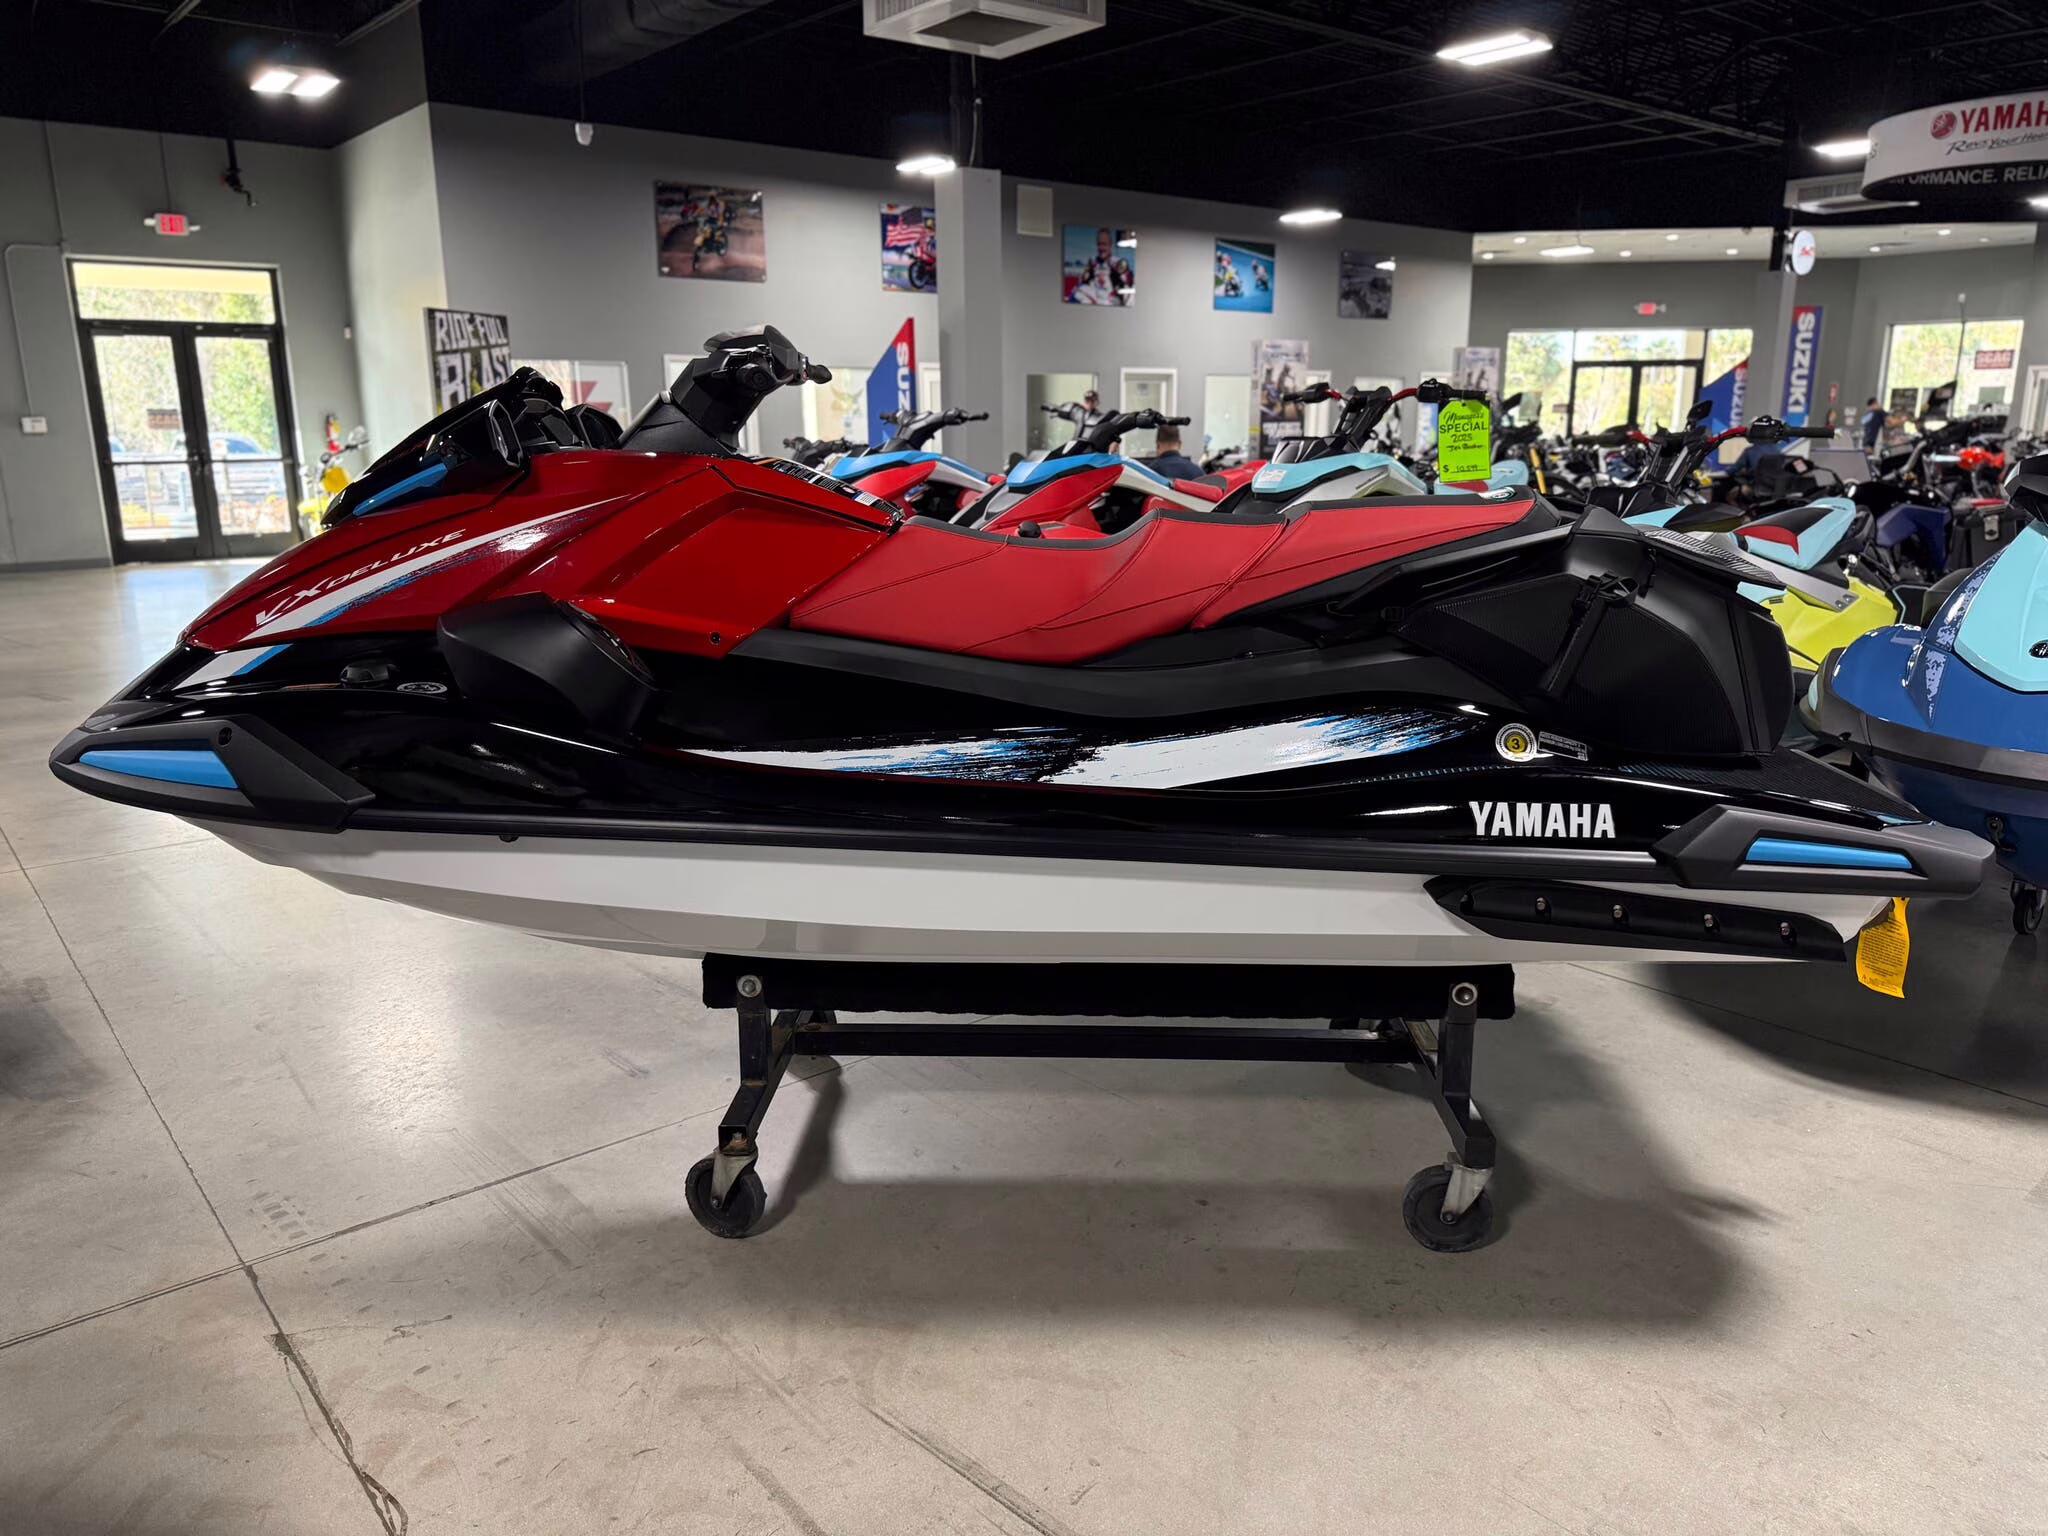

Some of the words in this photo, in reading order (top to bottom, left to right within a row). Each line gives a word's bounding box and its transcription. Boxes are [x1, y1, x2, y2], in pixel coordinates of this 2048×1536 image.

[434, 311, 479, 351] RIDE
[476, 316, 508, 345] FULL
[1788, 311, 1816, 414] SUZUKI
[1440, 422, 1487, 433] SPECIAL
[1511, 738, 1520, 750] 3
[1468, 801, 1616, 838] YAMAHA
